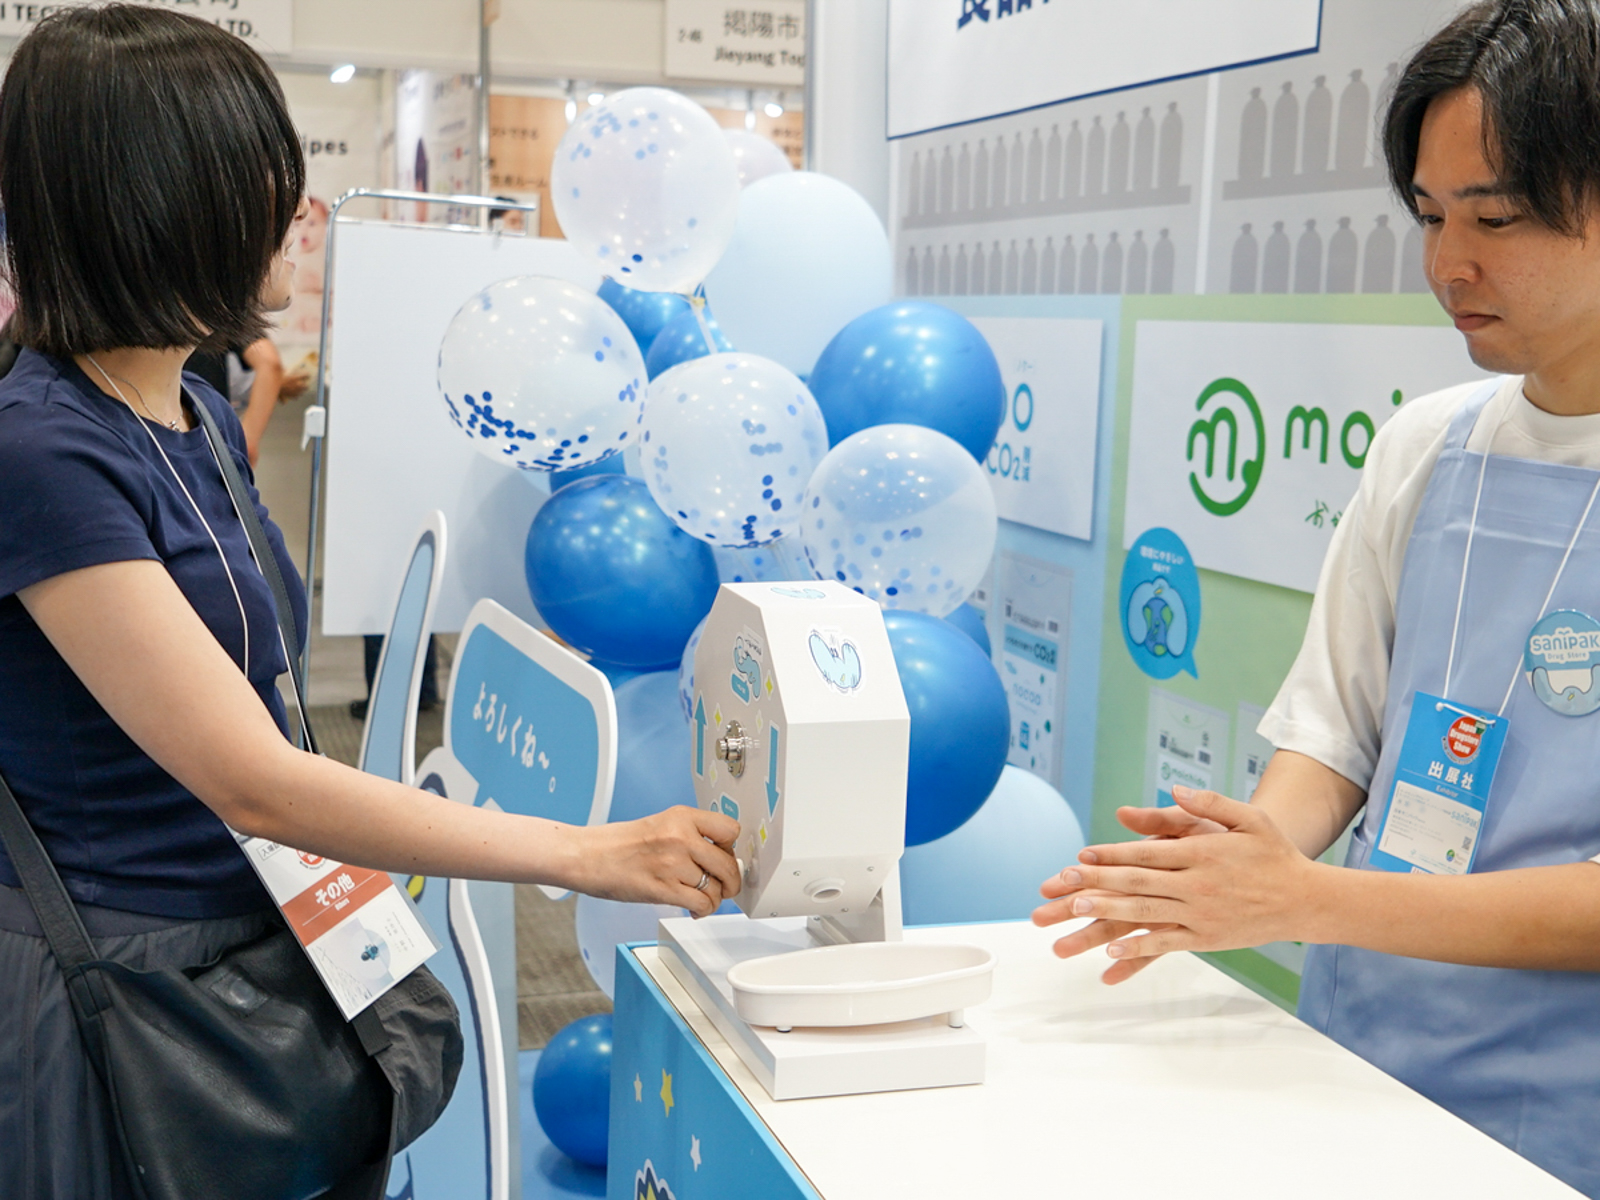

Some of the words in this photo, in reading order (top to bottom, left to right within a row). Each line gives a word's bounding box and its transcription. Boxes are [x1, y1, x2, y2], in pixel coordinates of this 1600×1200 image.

[715, 47, 775, 67] Jieyang
[302, 135, 348, 157] ipes
[1283, 389, 1403, 469] mo
[1547, 653, 1565, 661] Drug
[1567, 651, 1587, 659] Store
[1427, 760, 1474, 791] 出展社
[314, 872, 355, 907] その他
